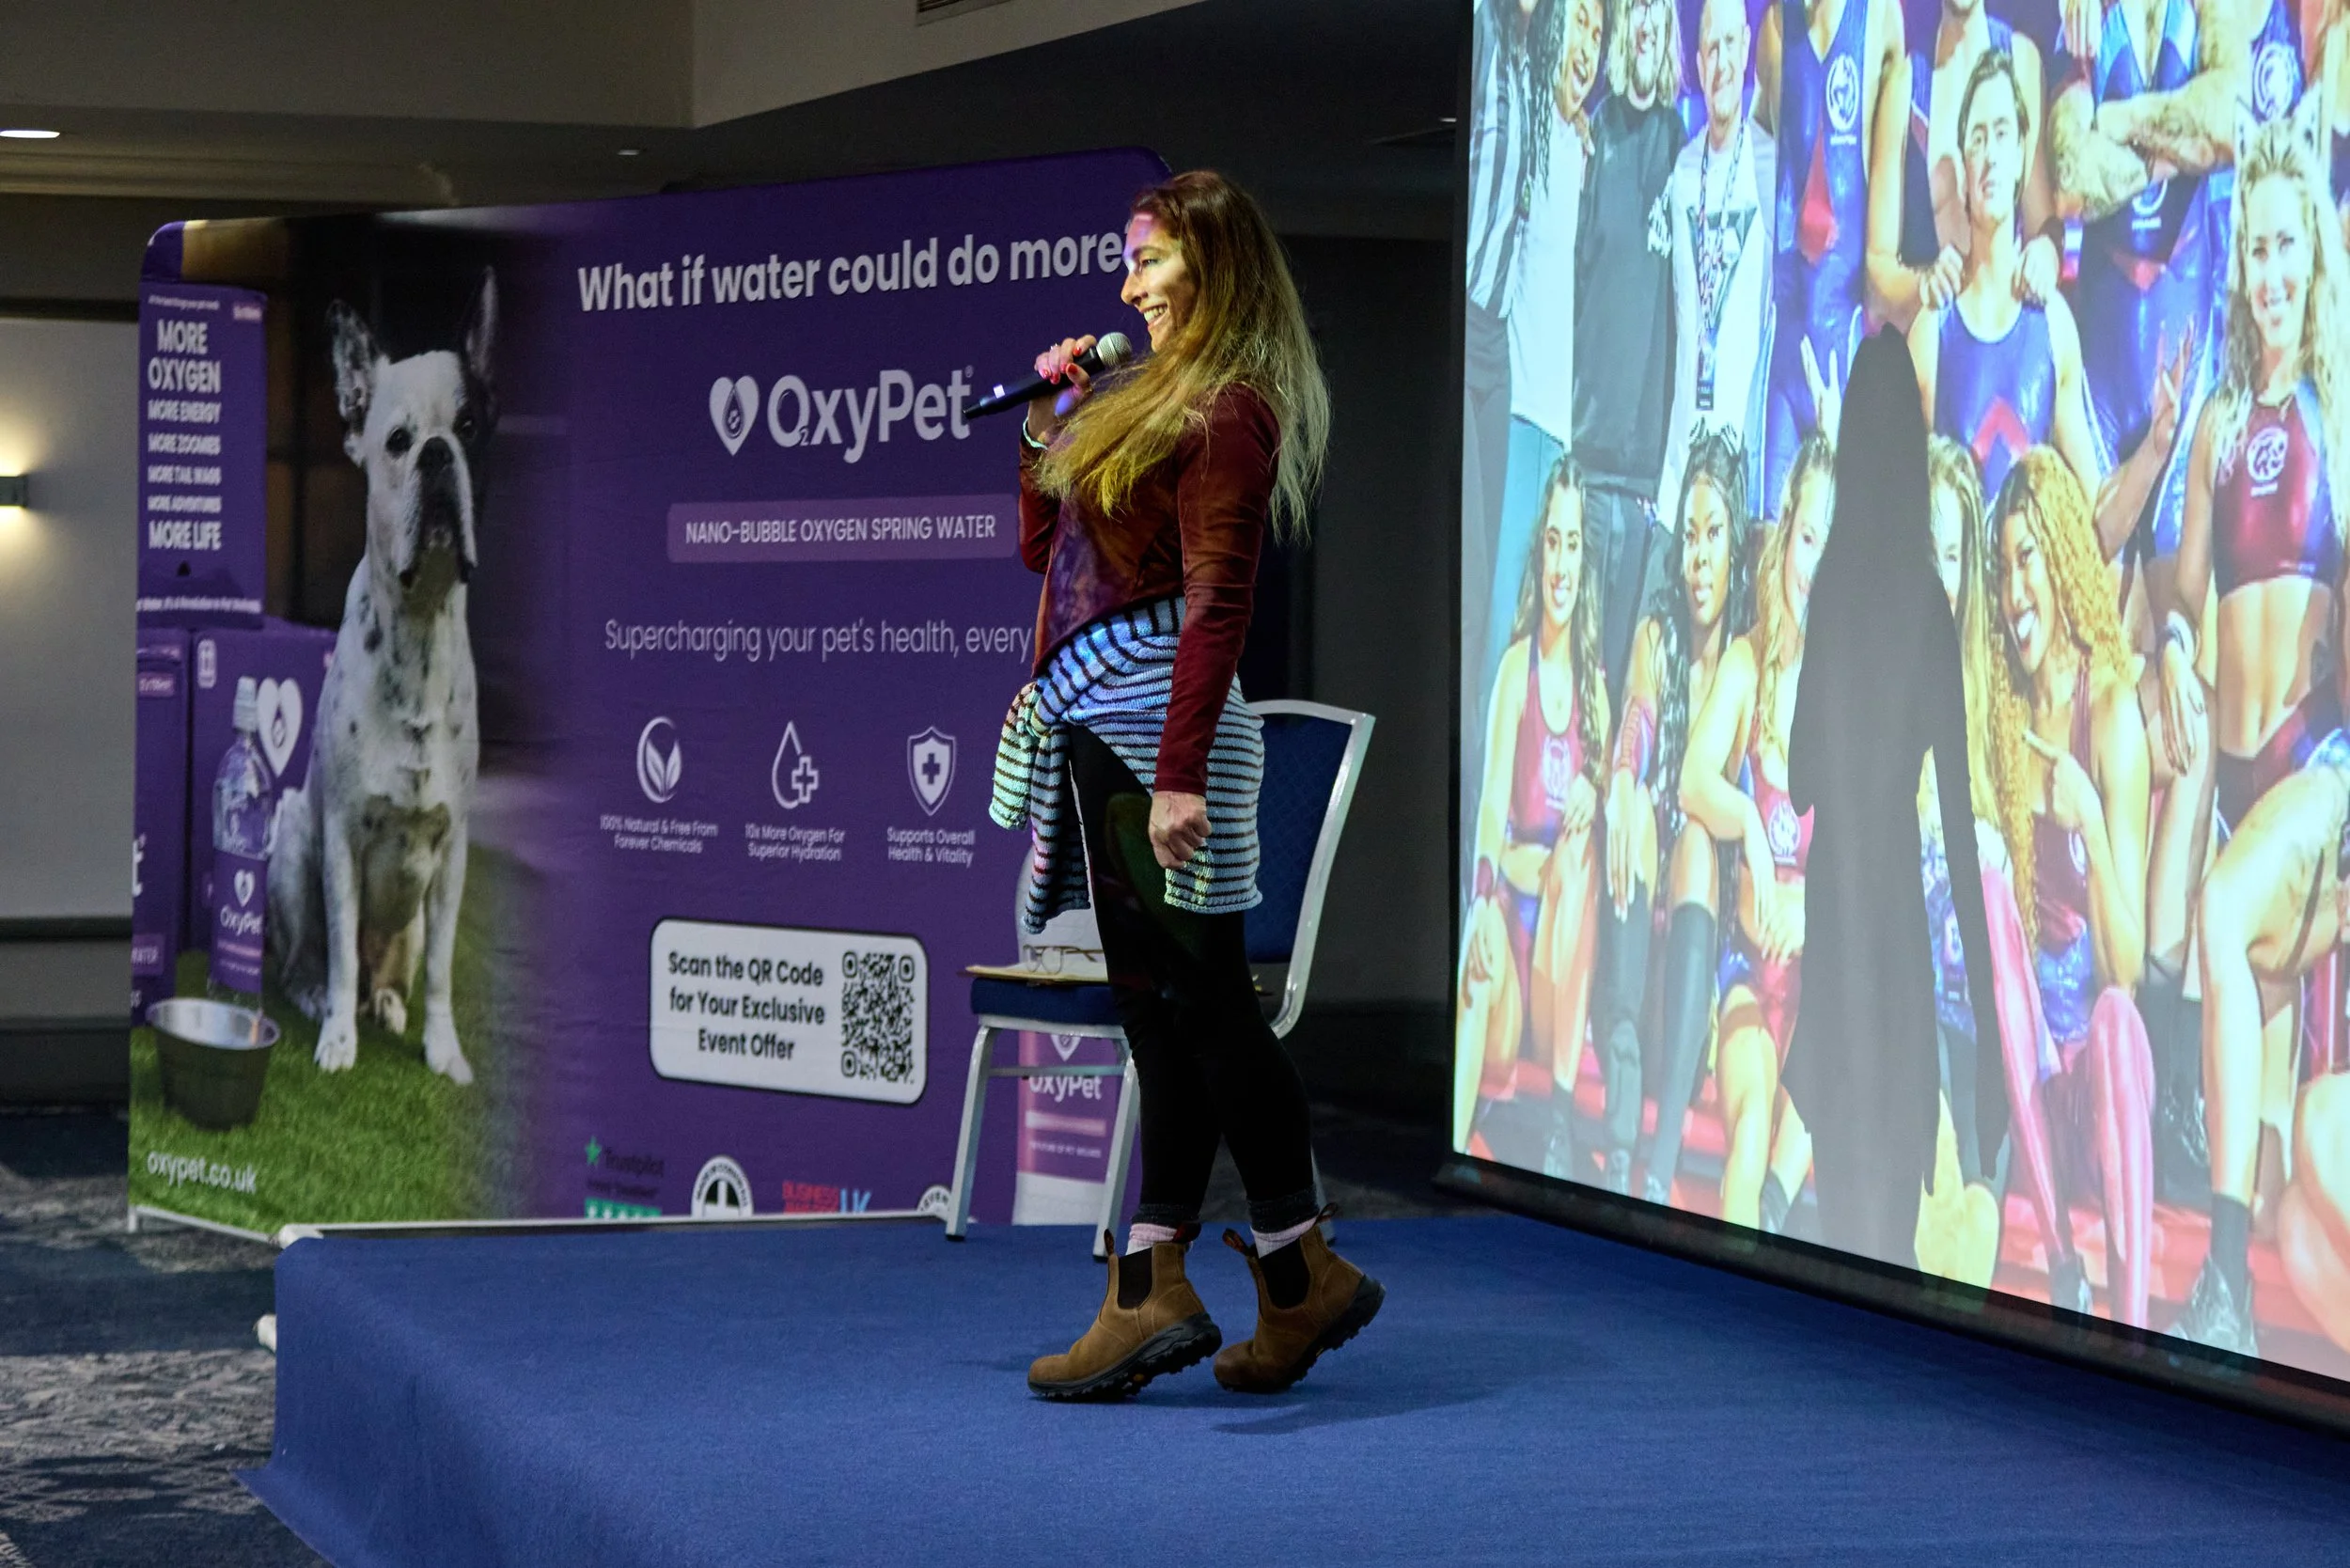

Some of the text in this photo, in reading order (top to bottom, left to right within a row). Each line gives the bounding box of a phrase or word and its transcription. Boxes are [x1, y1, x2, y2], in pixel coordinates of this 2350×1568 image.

[578, 261, 674, 311] What
[682, 254, 704, 306] if
[711, 254, 822, 305] water
[828, 237, 938, 295] could
[948, 234, 1000, 287] do
[157, 319, 208, 355] MORE
[148, 356, 222, 394] OXYGEN
[148, 399, 179, 421] MORE
[149, 520, 222, 551] MORE LIFE
[685, 514, 996, 544] NANO-BUBBLE OXYGEN SPRING WATER
[605, 617, 1032, 665] Supercharging your pet's health, every
[624, 817, 660, 834] Natural
[670, 818, 691, 836] Free
[693, 820, 718, 838] From
[761, 824, 787, 841] More
[789, 824, 827, 848] Oxygen
[828, 827, 845, 844] For
[886, 826, 976, 847] Supports Overall
[650, 835, 703, 854] Chemicals
[748, 841, 842, 865] Superior Hydration
[888, 845, 973, 869] Health & Vitality
[668, 949, 824, 987] Scan the QR Code
[669, 985, 825, 1026] for Your Exclusive
[697, 1027, 795, 1061] Event Offer
[148, 1150, 257, 1196] oxypet.co.uk
